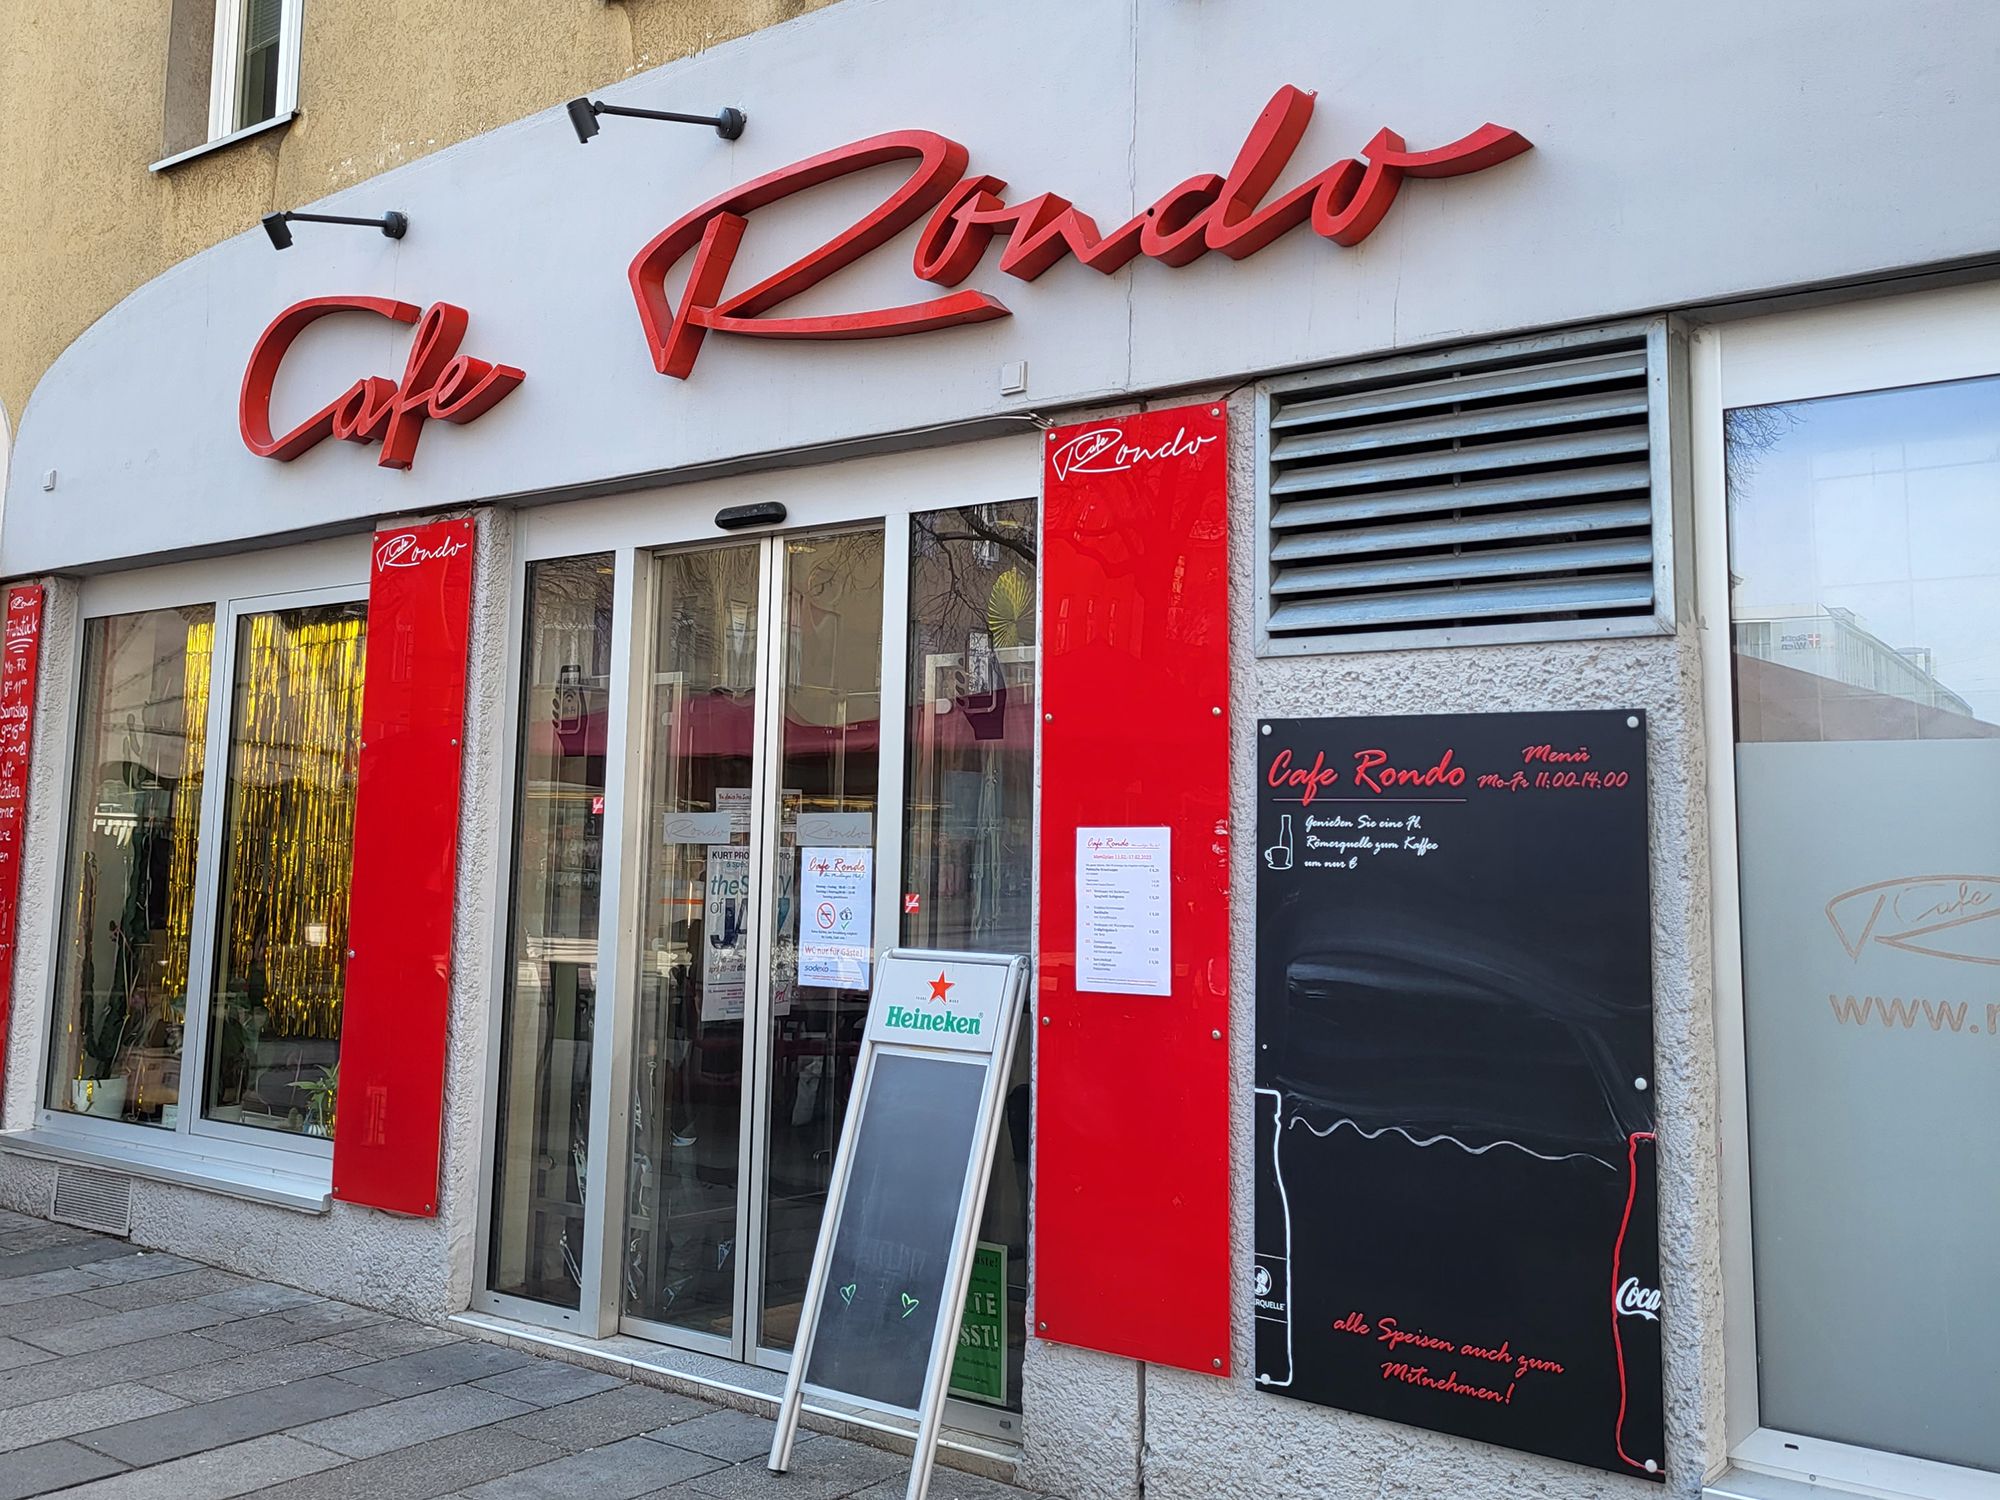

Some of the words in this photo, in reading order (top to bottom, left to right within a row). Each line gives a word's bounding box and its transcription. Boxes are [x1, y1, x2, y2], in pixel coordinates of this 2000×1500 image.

[239, 295, 526, 471] Cafe
[627, 83, 1535, 380] Rondo
[1052, 427, 1217, 481] Rondo
[376, 534, 467, 572] Rondo
[0, 697, 29, 721] Samstag
[1522, 744, 1591, 763] Menü
[1268, 749, 1339, 806] Cafe
[1354, 749, 1466, 794] Rondo
[1535, 771, 1629, 789] 11:00-14:00
[665, 819, 730, 839] Rondo
[800, 819, 871, 840] Rondo
[1305, 815, 1353, 832] Genießen
[1357, 815, 1377, 828] Sie
[1379, 819, 1404, 829] eine
[1106, 838, 1129, 848] Rondo
[1306, 835, 1373, 854] Römerquelle
[1374, 841, 1399, 855] zum
[1404, 836, 1439, 856] Kaffee
[712, 851, 733, 860] KURT
[734, 851, 750, 860] PRO
[1304, 860, 1322, 868] um
[1324, 860, 1346, 869] nur
[809, 857, 830, 877] Cafe
[834, 858, 866, 873] Rondo
[711, 874, 750, 896] theS
[710, 897, 725, 914] of
[804, 945, 816, 954] WC
[830, 947, 840, 955] für
[885, 1005, 981, 1035] Heineken
[1829, 994, 2000, 1035] www.r
[960, 1324, 999, 1347] SST!
[1333, 1311, 1370, 1335] alle
[1377, 1317, 1455, 1350] Speisen
[1460, 1341, 1513, 1363] auch
[1515, 1354, 1565, 1378] zum
[1380, 1361, 1515, 1405] Mitnehmen!
